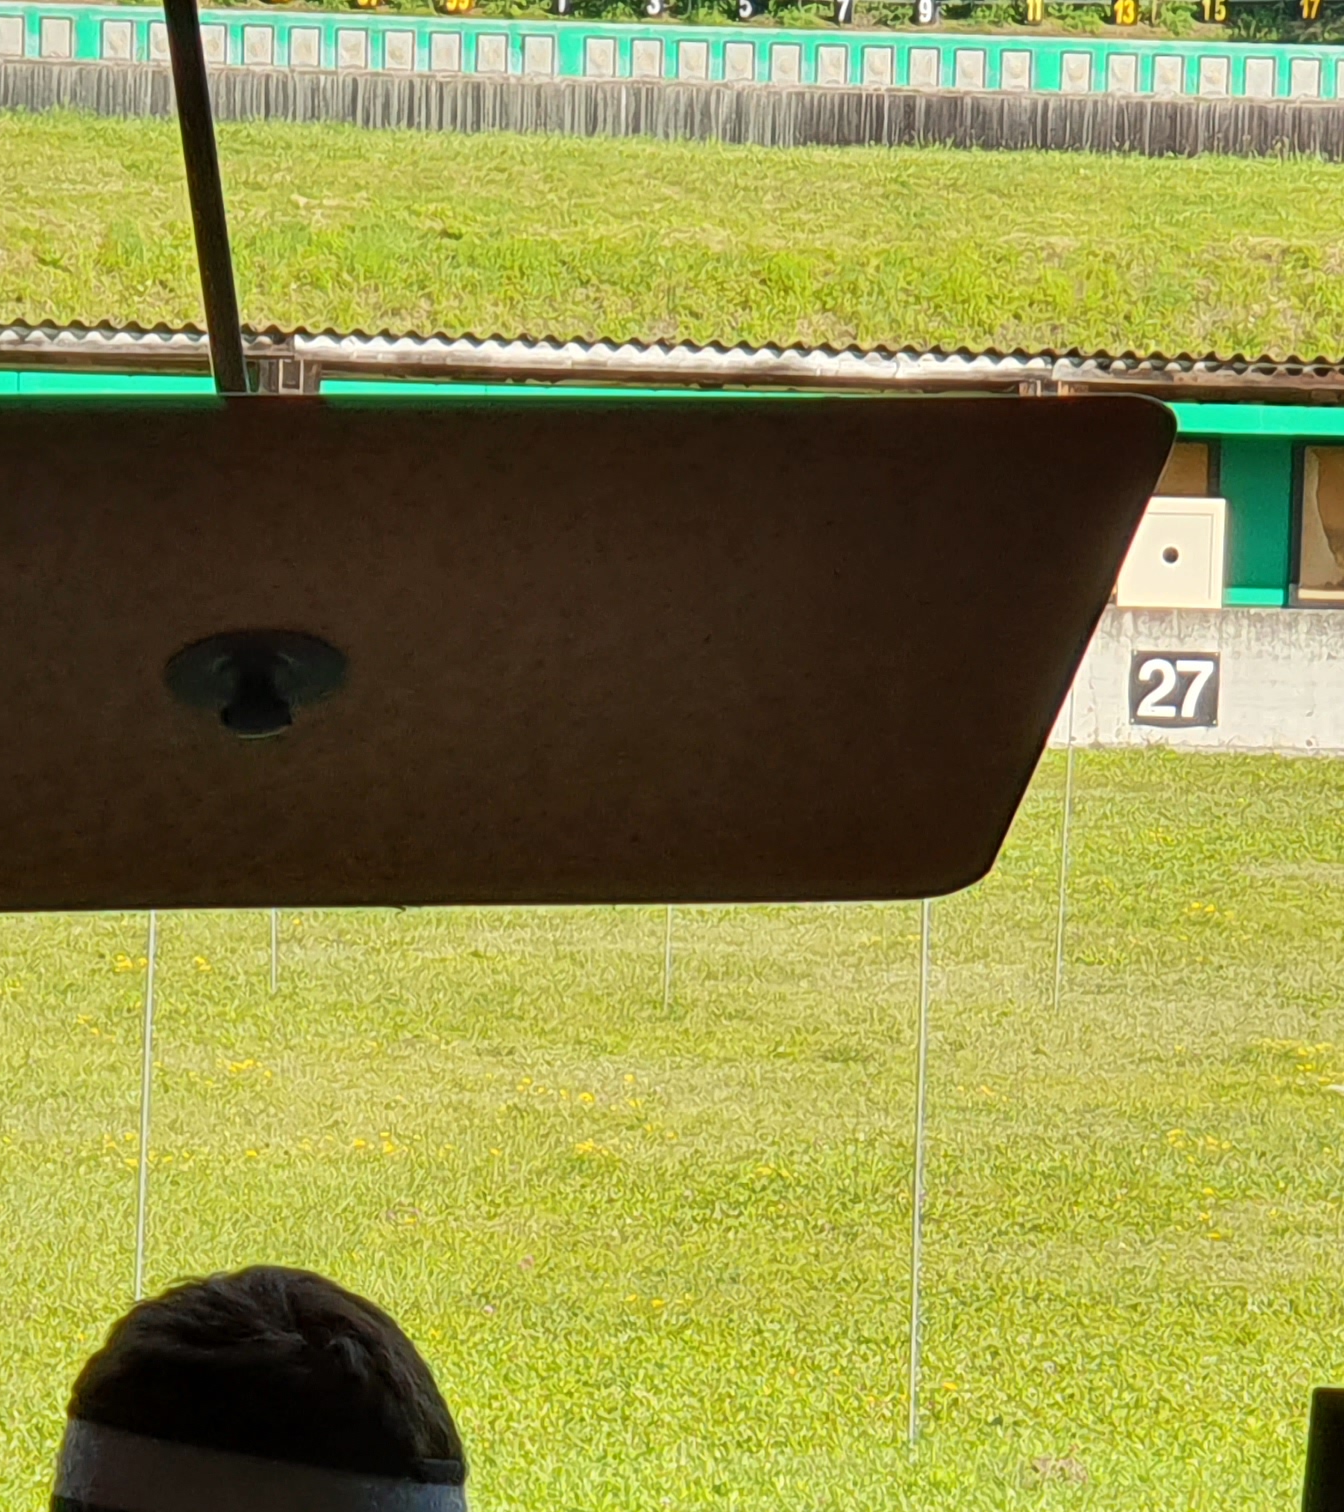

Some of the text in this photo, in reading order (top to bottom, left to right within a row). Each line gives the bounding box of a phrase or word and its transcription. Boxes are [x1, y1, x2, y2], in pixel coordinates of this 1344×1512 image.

[838, 0, 849, 21] 7
[918, 0, 933, 23] 9
[1027, 0, 1042, 21] 11
[1114, 0, 1136, 24] 13
[1204, 0, 1226, 22] 15
[1301, 0, 1320, 19] 17
[1137, 658, 1215, 719] 27
